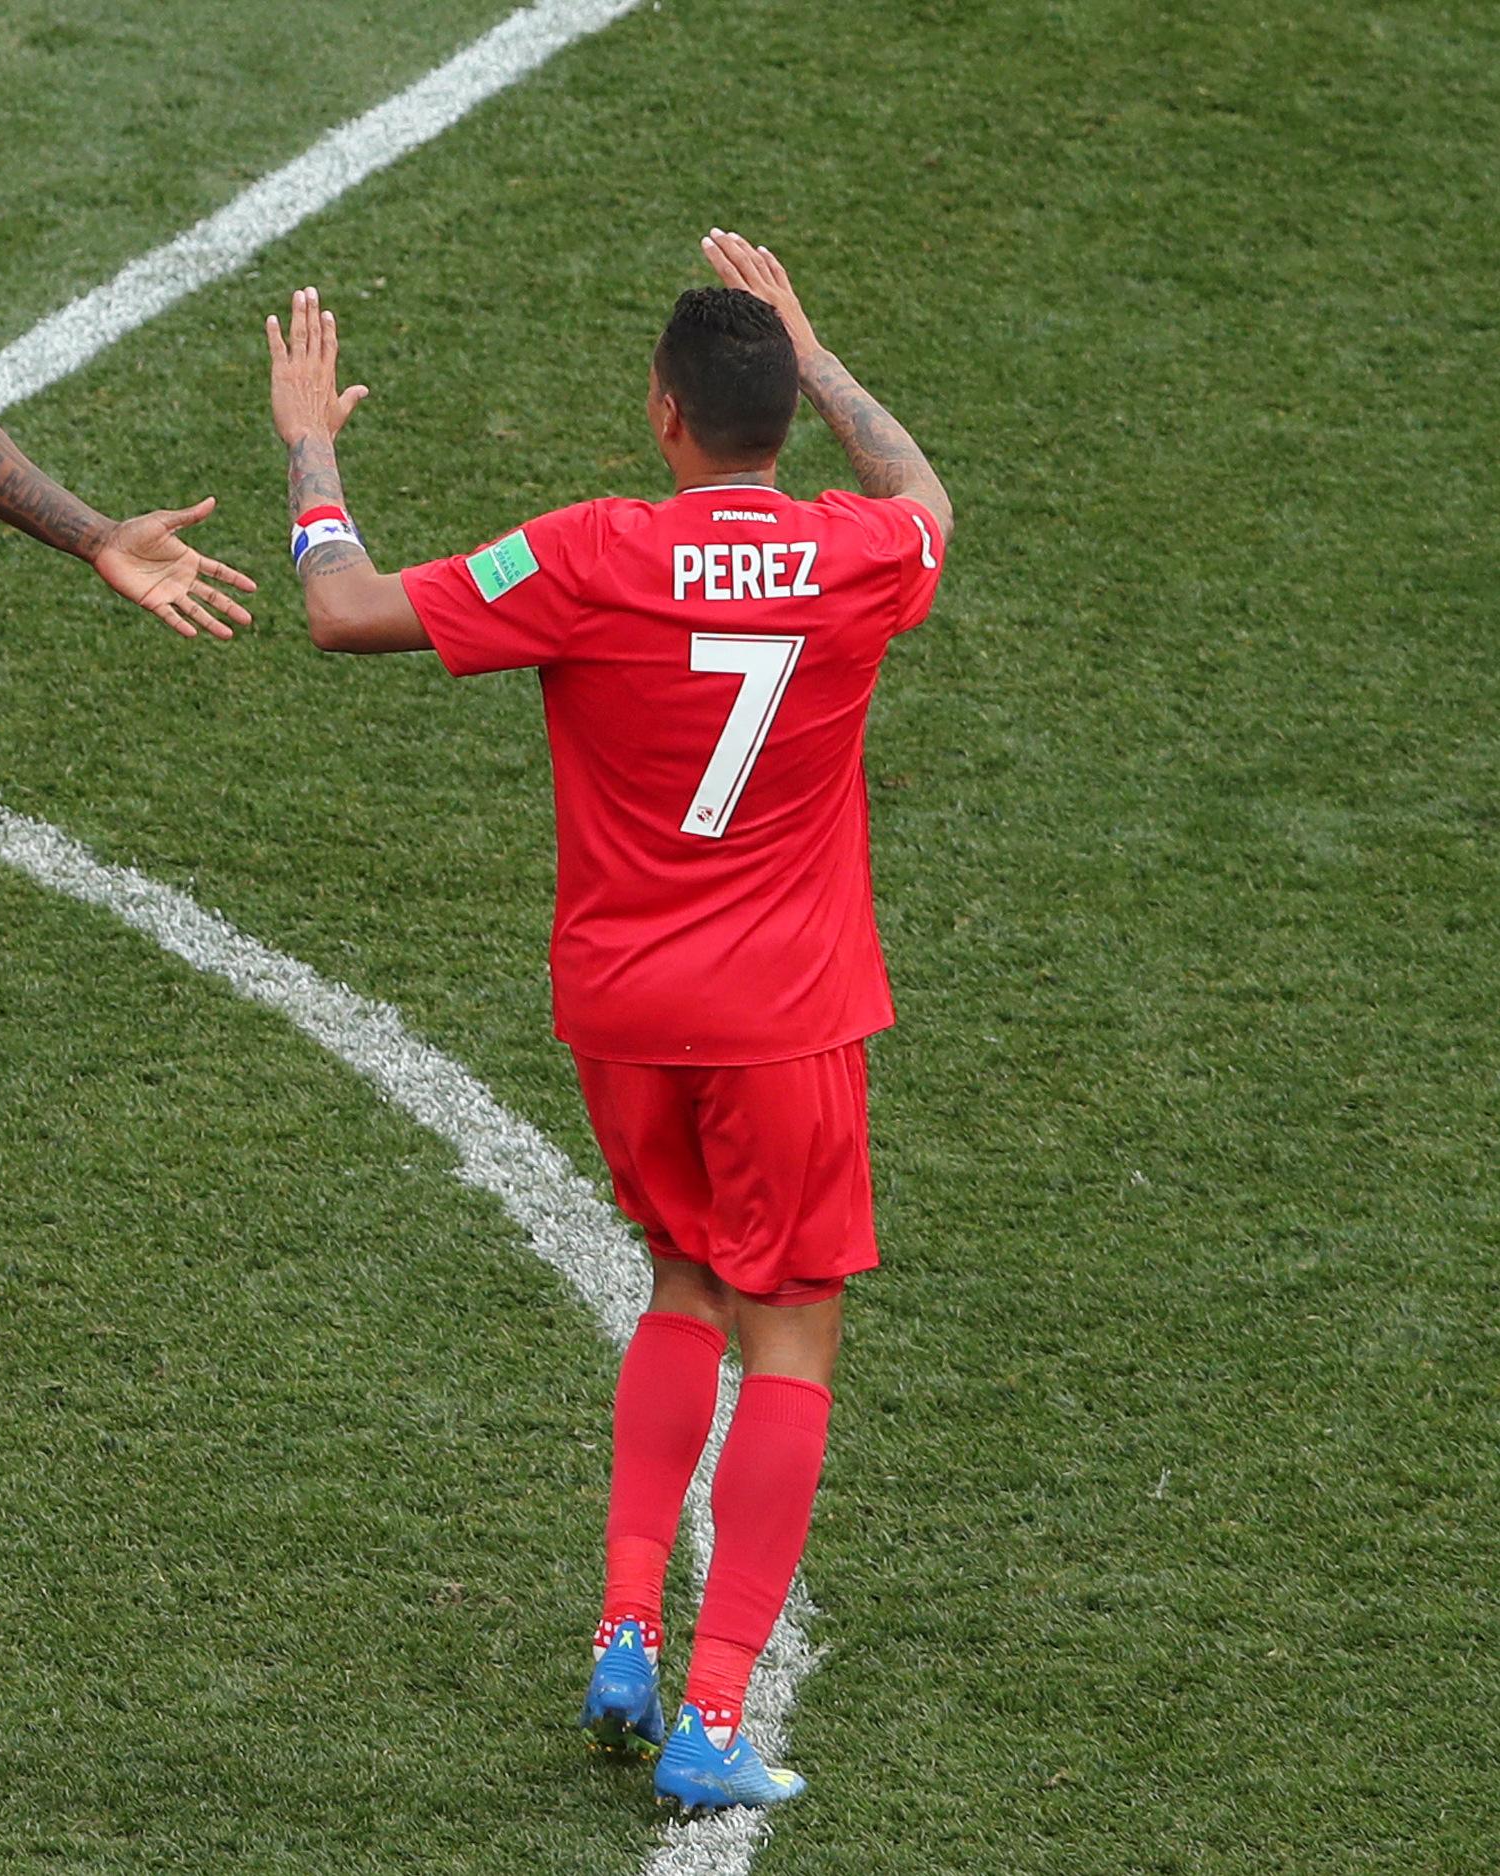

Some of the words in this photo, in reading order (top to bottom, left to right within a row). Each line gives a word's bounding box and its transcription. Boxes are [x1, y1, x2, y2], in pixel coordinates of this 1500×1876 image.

[712, 510, 777, 523] PANAMA
[673, 541, 820, 600] PEREZ
[681, 633, 804, 837] 7
